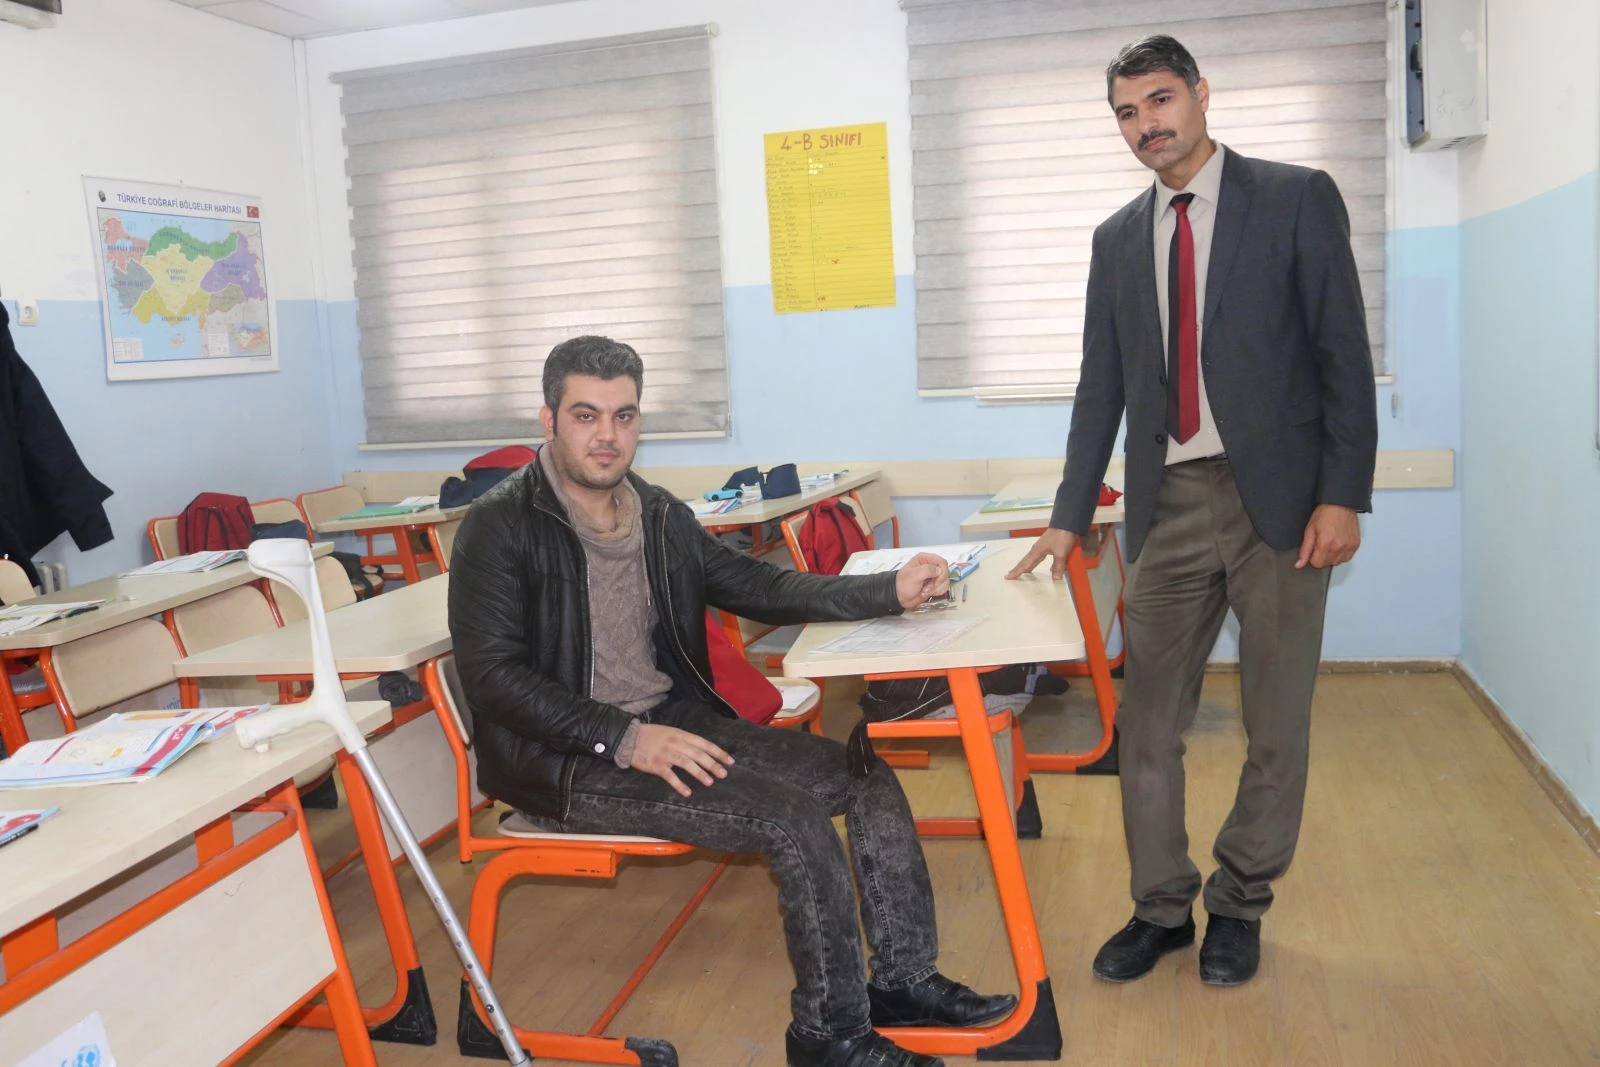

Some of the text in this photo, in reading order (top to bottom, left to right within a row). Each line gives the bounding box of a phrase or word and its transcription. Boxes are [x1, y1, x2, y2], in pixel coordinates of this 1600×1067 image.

[780, 133, 861, 151] 4-B SINIFI
[117, 193, 241, 214] TÜRKİYE COĞRAFİ BÖLGELER HARİTASI
